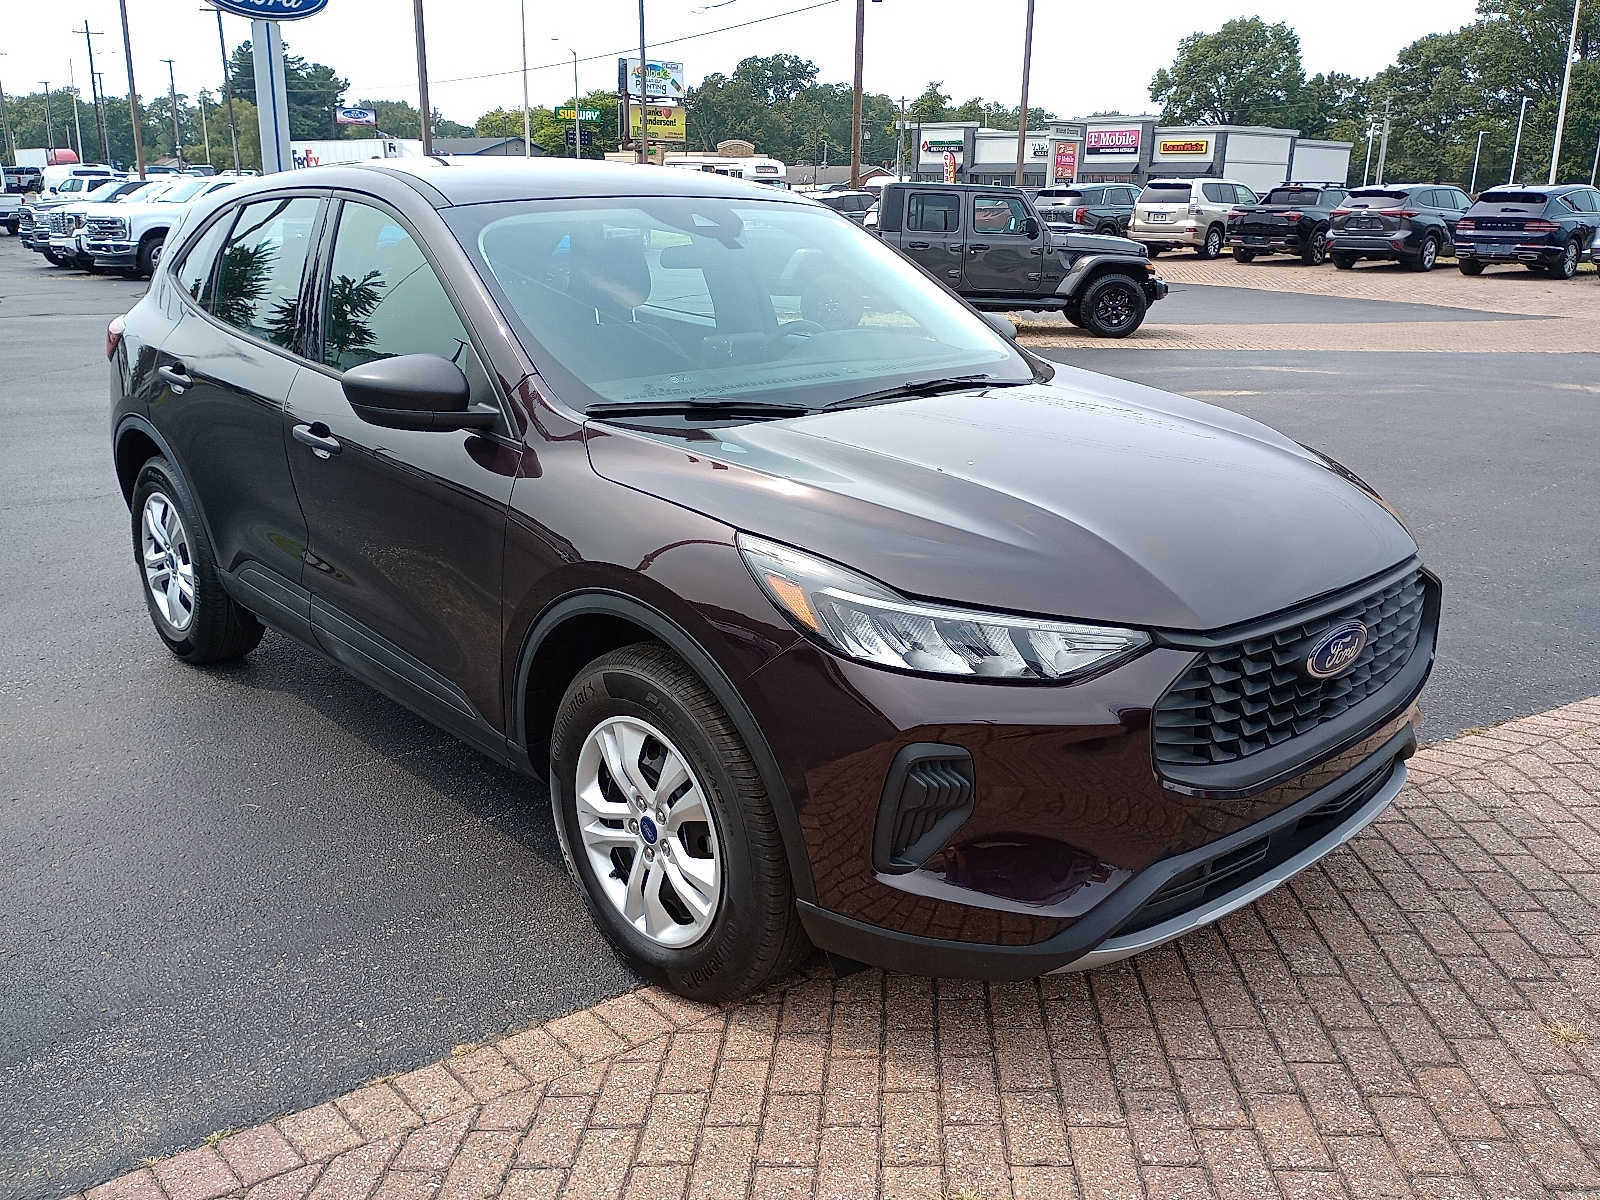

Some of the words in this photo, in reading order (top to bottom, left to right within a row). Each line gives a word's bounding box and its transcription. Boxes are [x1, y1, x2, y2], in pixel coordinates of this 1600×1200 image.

[558, 109, 600, 120] SUBWAY
[640, 107, 662, 117] Tanks
[639, 117, 676, 126] nderson!
[1163, 143, 1204, 152] LoanMax
[1325, 634, 1359, 669] Ford
